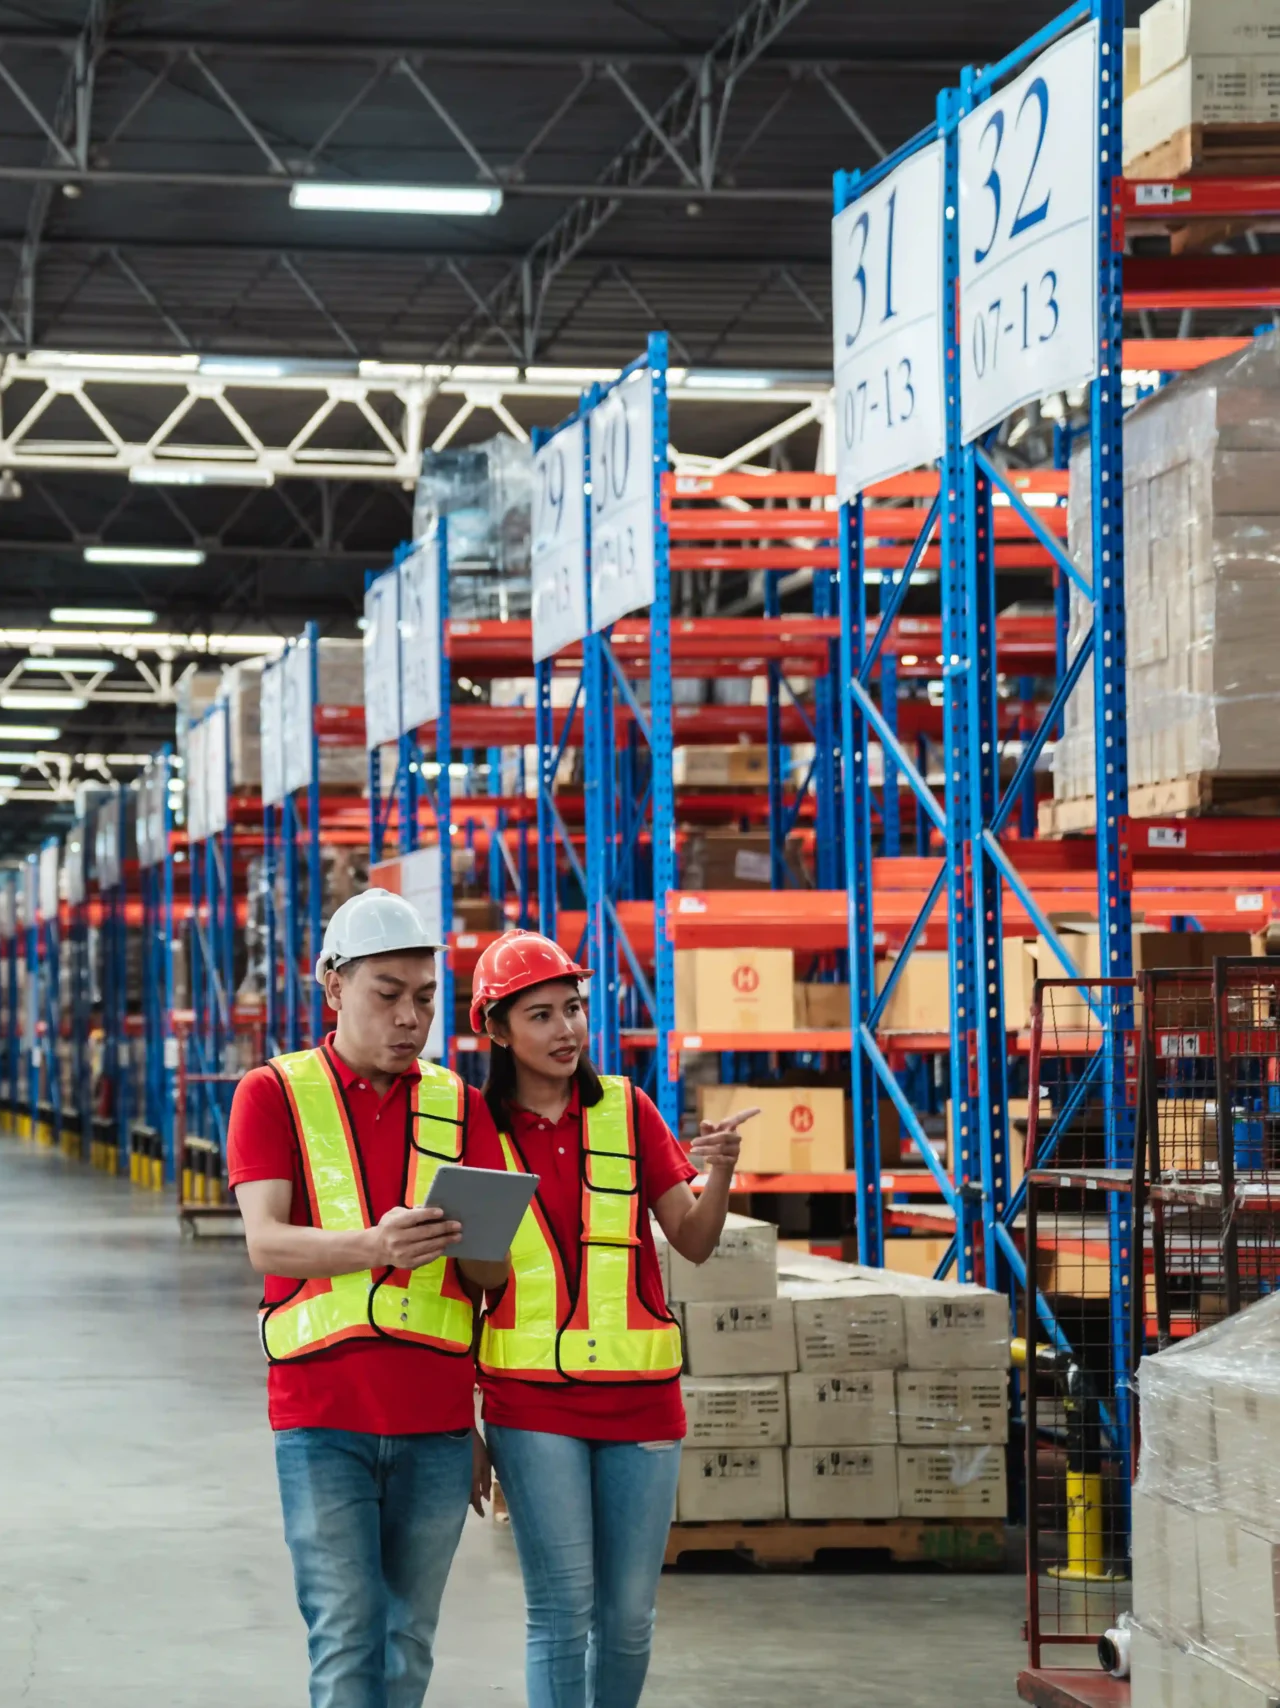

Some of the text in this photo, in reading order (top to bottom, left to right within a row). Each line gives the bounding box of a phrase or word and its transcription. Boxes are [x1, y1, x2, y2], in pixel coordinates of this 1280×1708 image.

[974, 76, 1052, 264] 32
[845, 185, 898, 348] 31
[972, 269, 1060, 380] 07-13
[844, 357, 916, 451] 07-13
